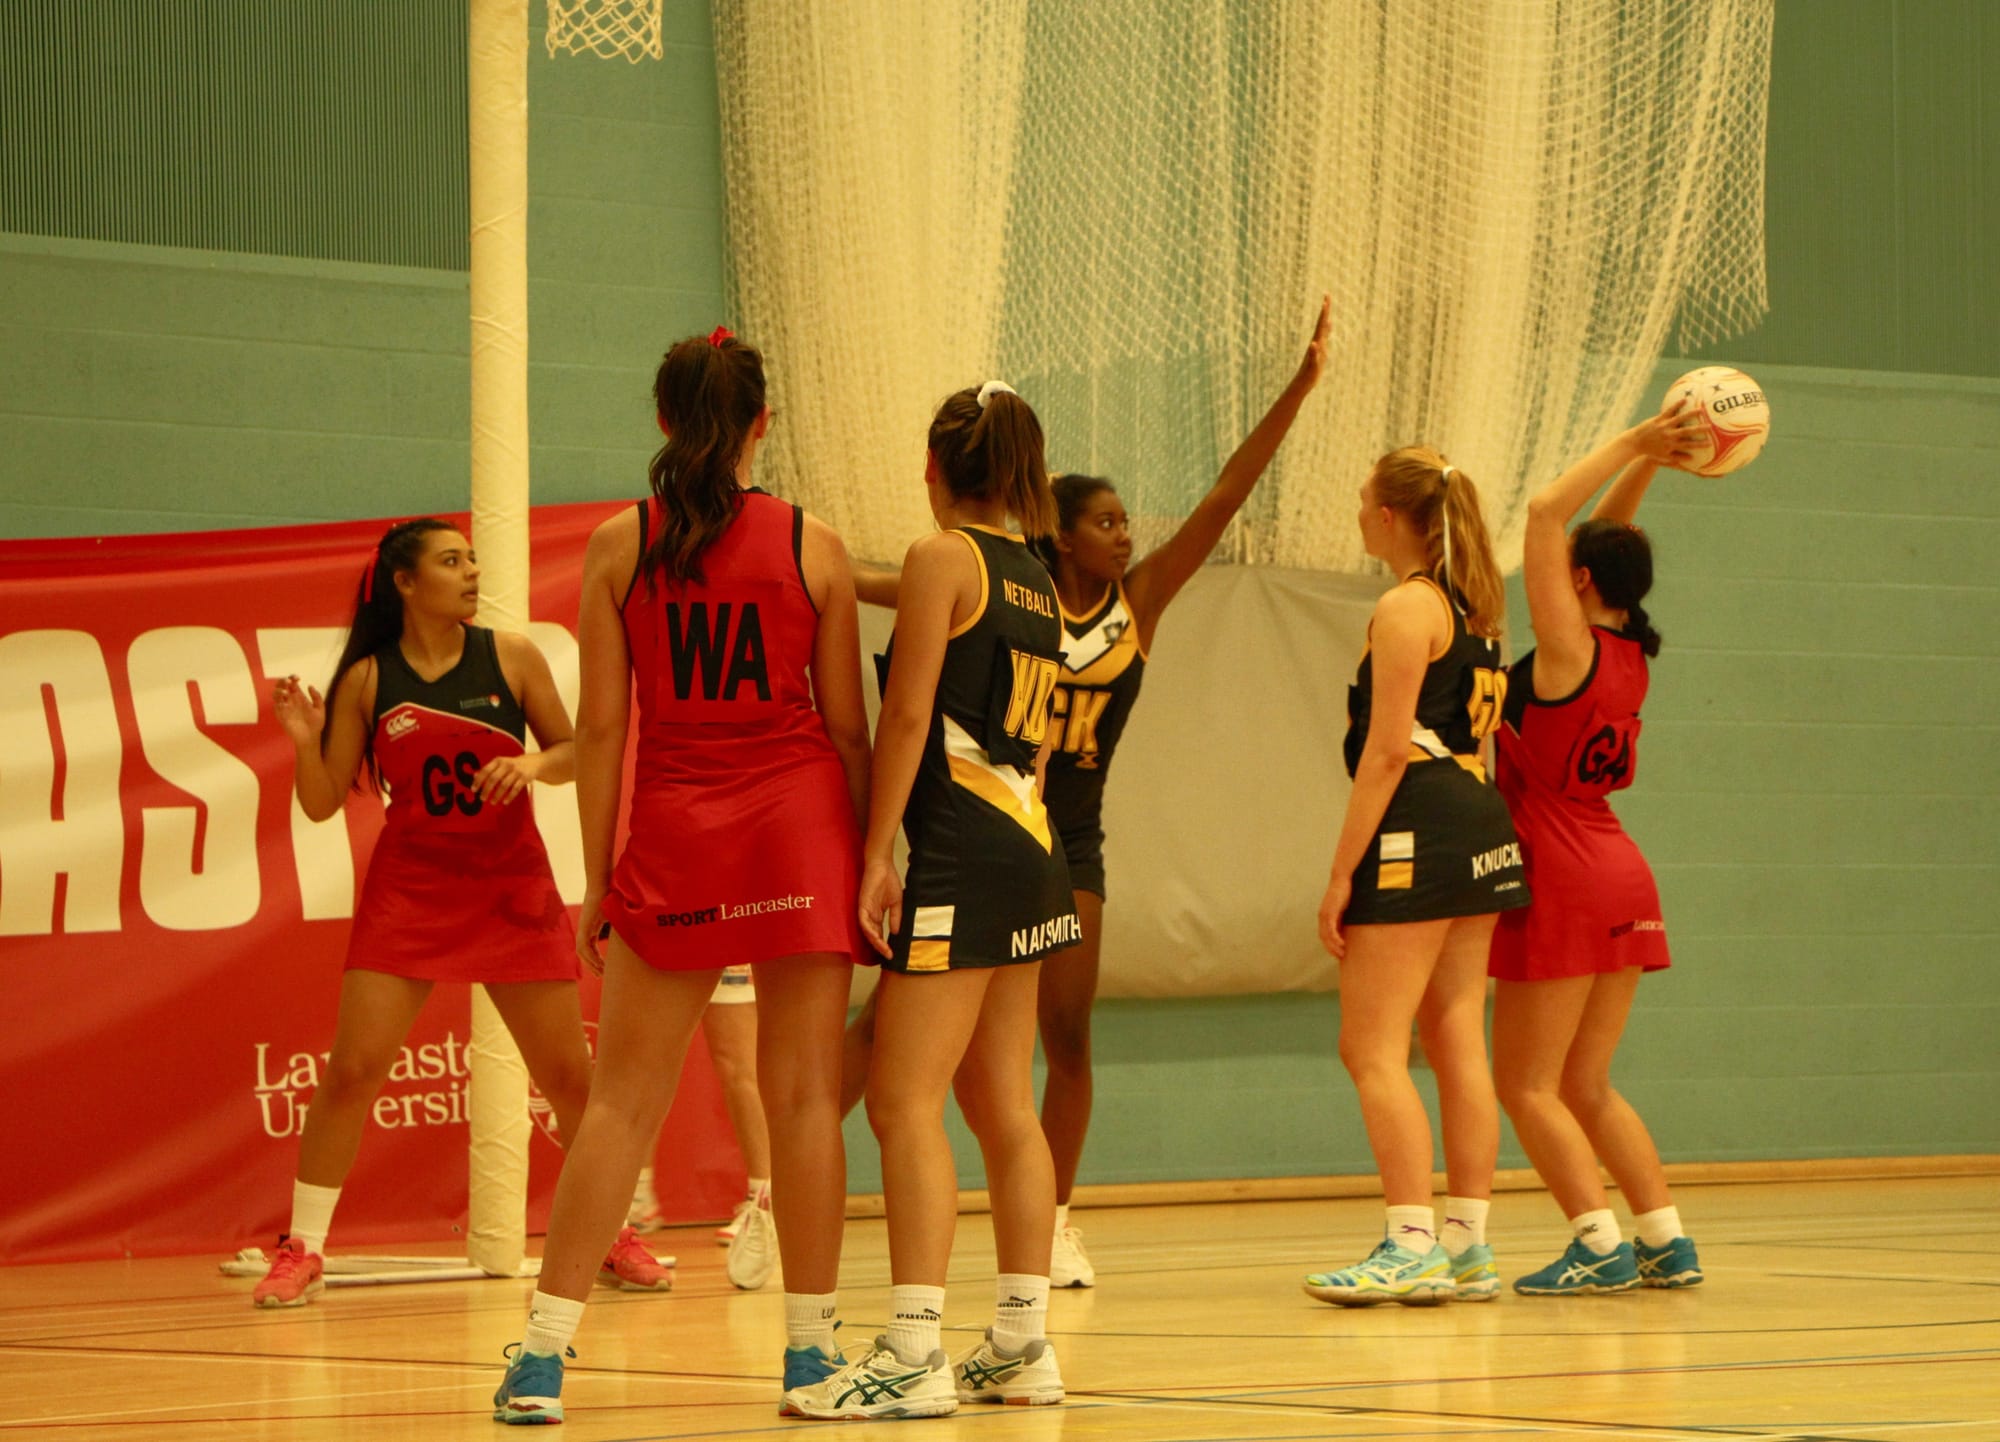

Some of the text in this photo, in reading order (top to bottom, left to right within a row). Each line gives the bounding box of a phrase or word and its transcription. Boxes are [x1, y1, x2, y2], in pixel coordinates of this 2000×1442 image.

[1003, 578, 1055, 619] NETBALL
[666, 602, 773, 701] WA
[422, 751, 484, 817] GS
[655, 892, 815, 928] SPORT Lancaster
[1011, 913, 1083, 959] NAISMITH
